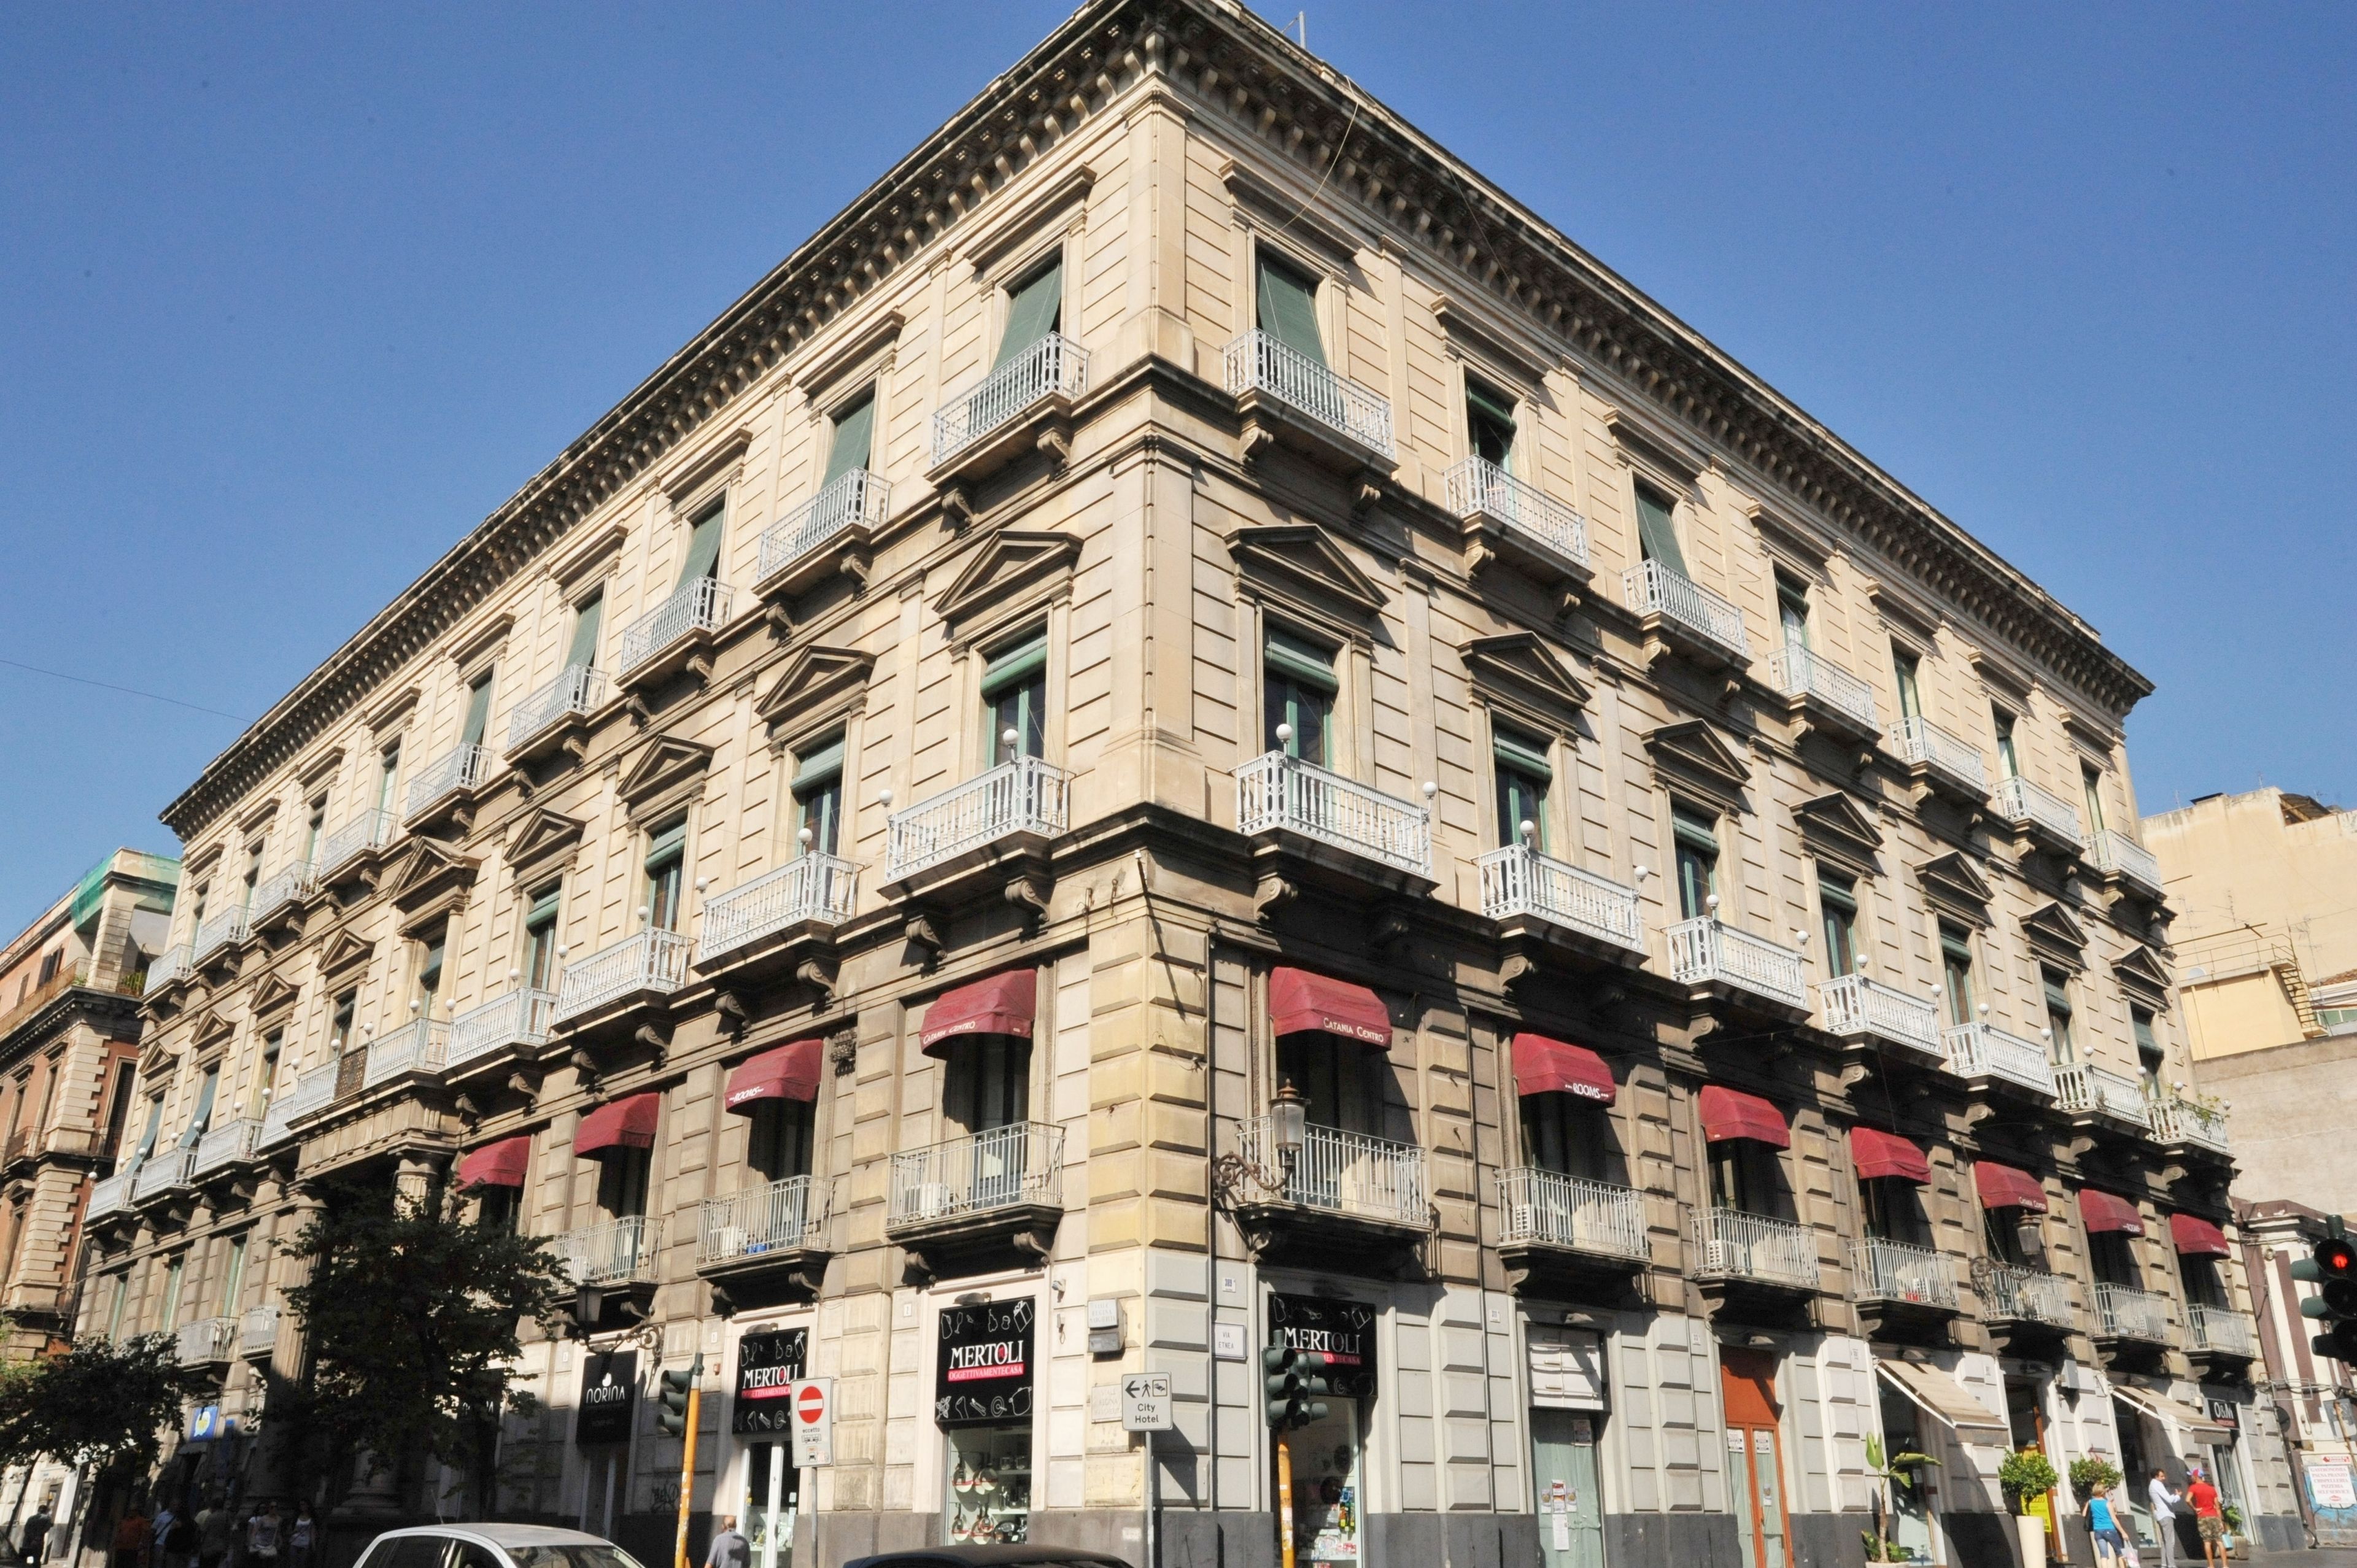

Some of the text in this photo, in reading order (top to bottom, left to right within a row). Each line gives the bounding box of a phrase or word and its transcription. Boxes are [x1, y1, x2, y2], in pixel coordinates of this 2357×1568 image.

[1323, 1018, 1384, 1043] CATANIA CENTRO
[1284, 1327, 1361, 1354] MERTOLI
[949, 1340, 1024, 1370] MERTOLI
[742, 1364, 799, 1389] MERTOLI
[1135, 1415, 1159, 1423] Hotel
[1137, 1403, 1156, 1412] City
